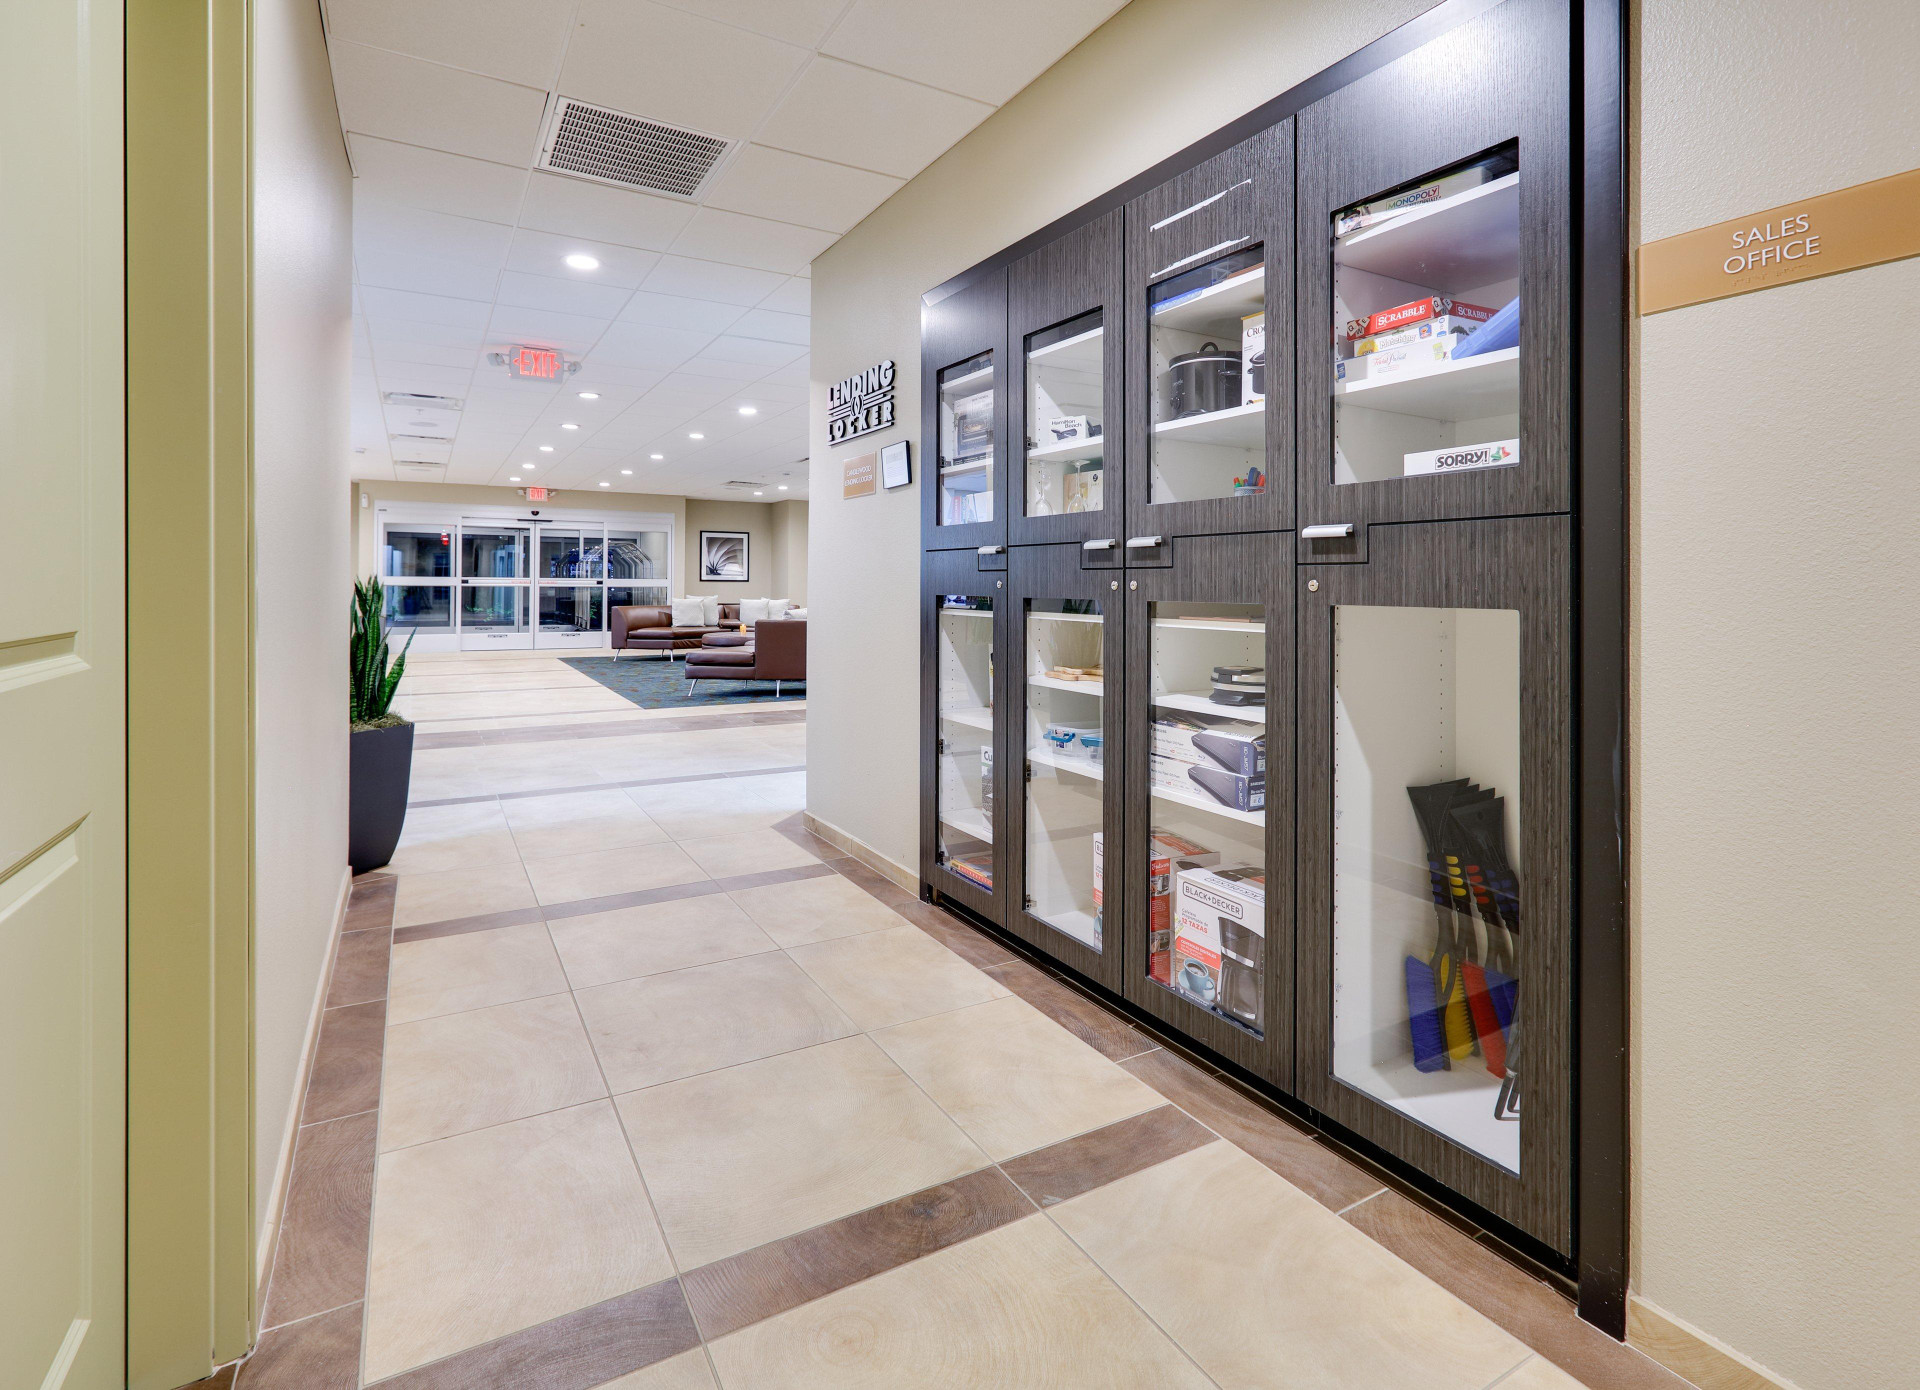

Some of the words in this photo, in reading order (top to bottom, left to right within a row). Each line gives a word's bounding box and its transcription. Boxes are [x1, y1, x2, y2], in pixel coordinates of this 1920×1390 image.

[1387, 187, 1439, 210] MONOPOLY
[1732, 213, 1810, 249] SALES
[1722, 235, 1821, 275] OFFICE
[1377, 304, 1427, 326] SCRABBLE
[1246, 325, 1265, 338] CRO
[520, 349, 557, 379] EXIT
[826, 360, 896, 411] LENDING
[827, 401, 895, 442] LOCKER
[1437, 450, 1488, 469] SORRY!
[530, 488, 546, 500] EXIT
[1185, 885, 1241, 915] BLACK+DECKER
[1188, 920, 1208, 934] TAZAS
